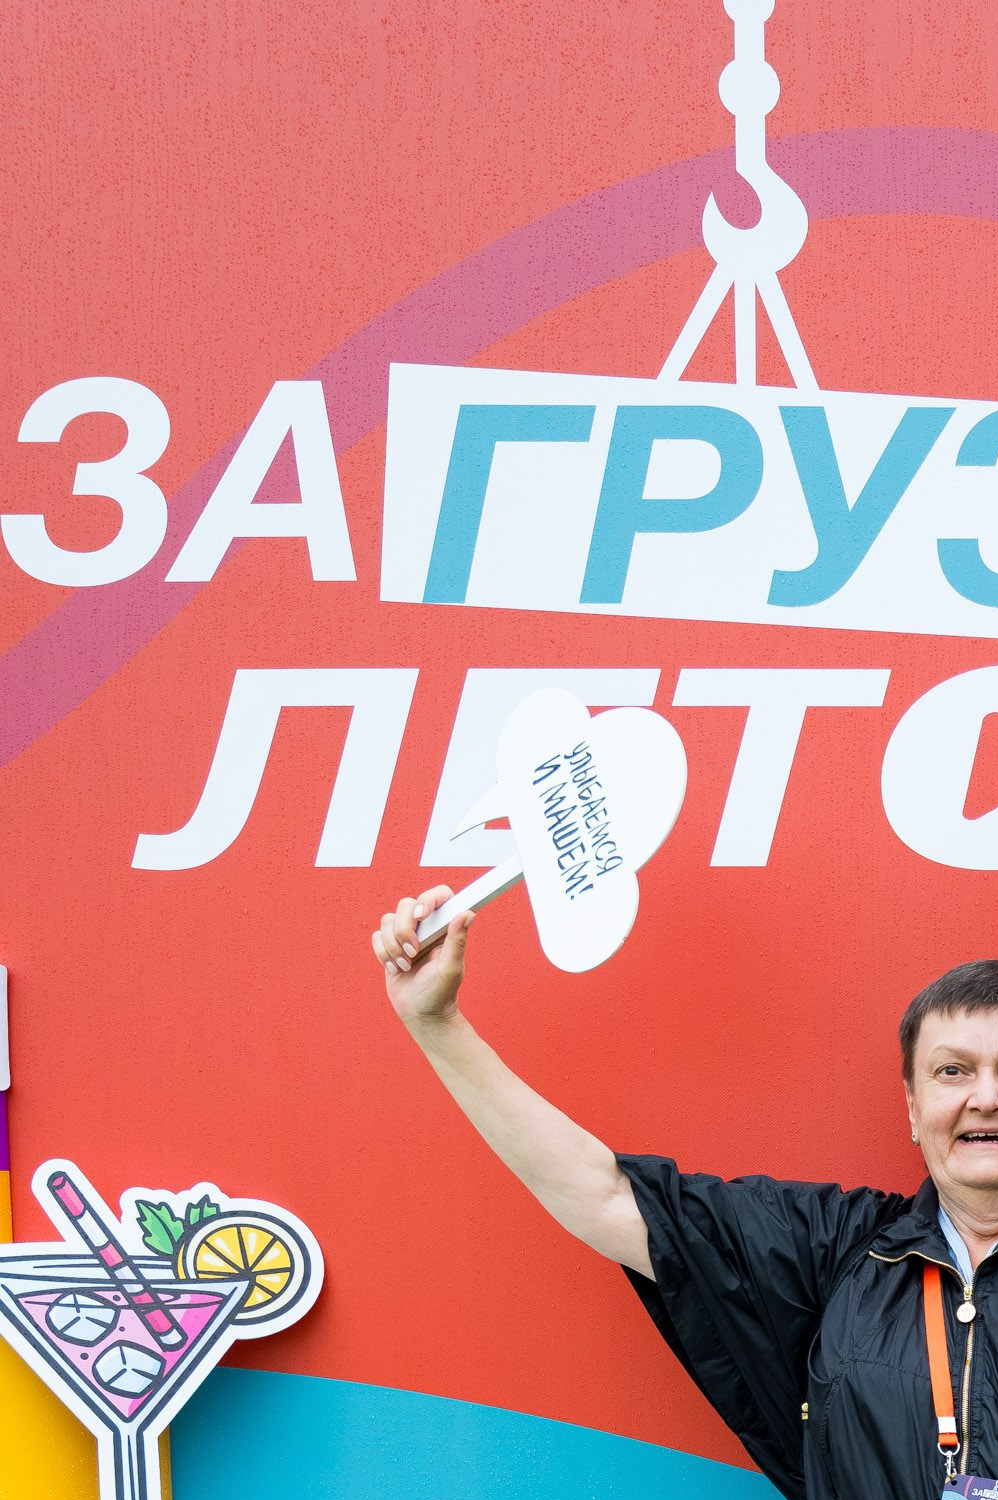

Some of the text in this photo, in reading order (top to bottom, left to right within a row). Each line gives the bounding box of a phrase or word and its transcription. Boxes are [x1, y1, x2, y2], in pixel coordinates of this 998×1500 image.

[532, 754, 594, 901] И МАШЕМ!
[563, 740, 624, 877] УЛЫБАЕМСЯ
